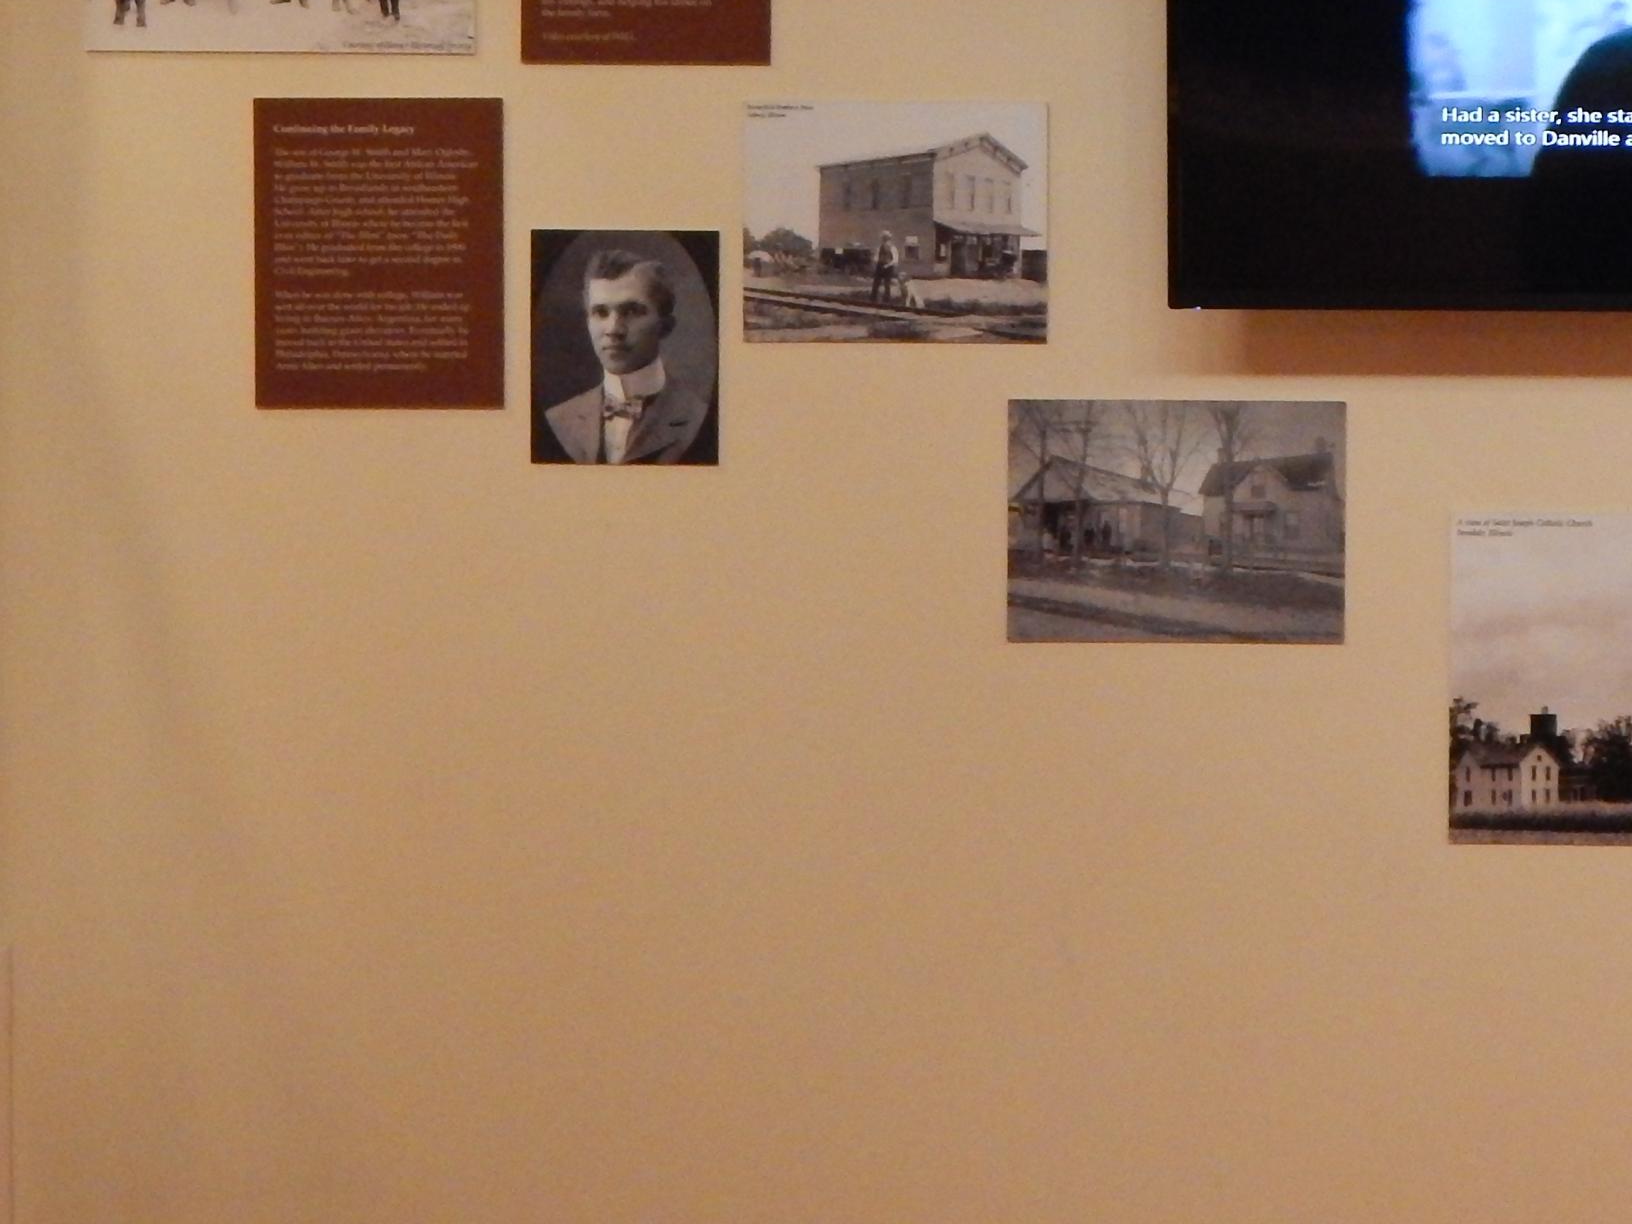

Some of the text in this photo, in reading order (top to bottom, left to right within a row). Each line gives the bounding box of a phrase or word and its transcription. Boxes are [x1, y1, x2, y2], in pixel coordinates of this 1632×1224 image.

[1441, 107, 1483, 123] Had
[1488, 110, 1500, 123] a
[1505, 108, 1562, 125] sister,
[1567, 108, 1602, 123] she
[1441, 130, 1510, 146] moved
[1515, 131, 1536, 146] to
[1542, 130, 1620, 146] Danville
